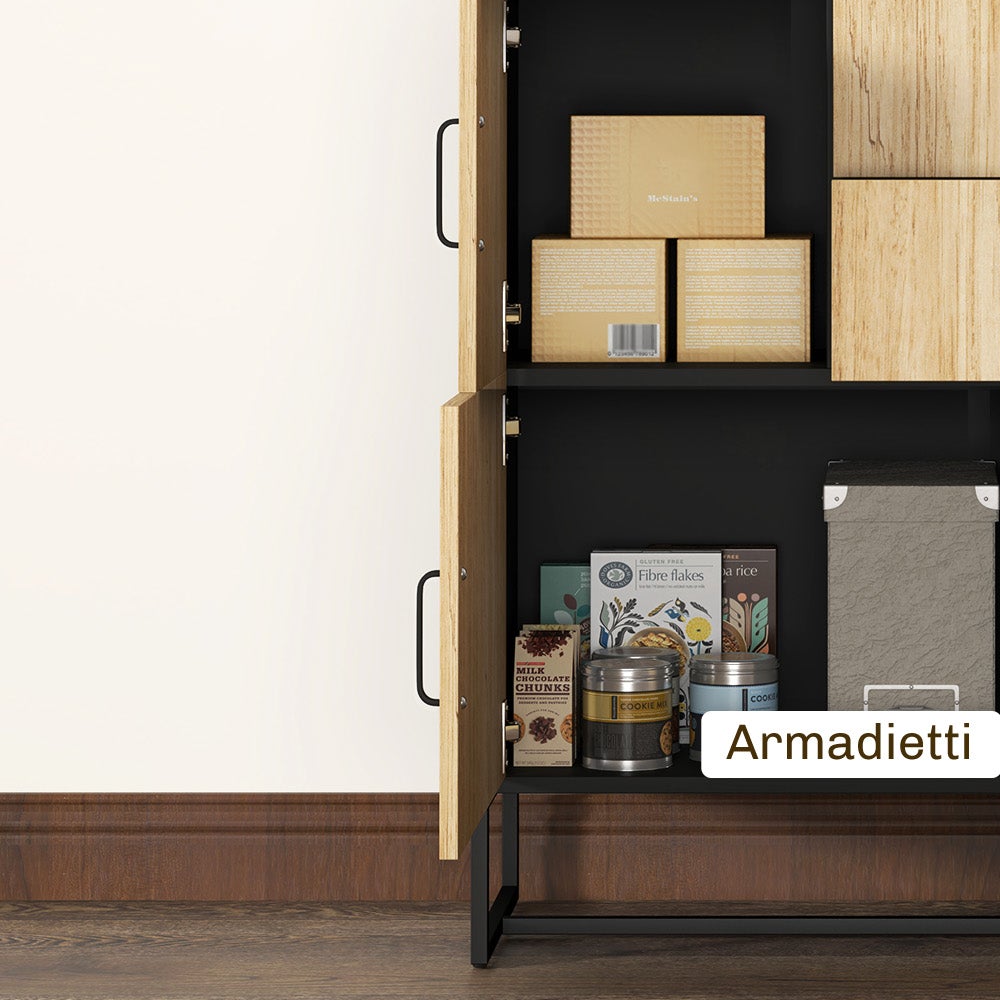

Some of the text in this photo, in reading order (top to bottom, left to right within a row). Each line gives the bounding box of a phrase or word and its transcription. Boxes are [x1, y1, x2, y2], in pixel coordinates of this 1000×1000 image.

[639, 569, 704, 581] Fibre flakes
[736, 564, 758, 576] rice
[516, 684, 570, 692] CHUNKS
[620, 702, 655, 710] COOKIE
